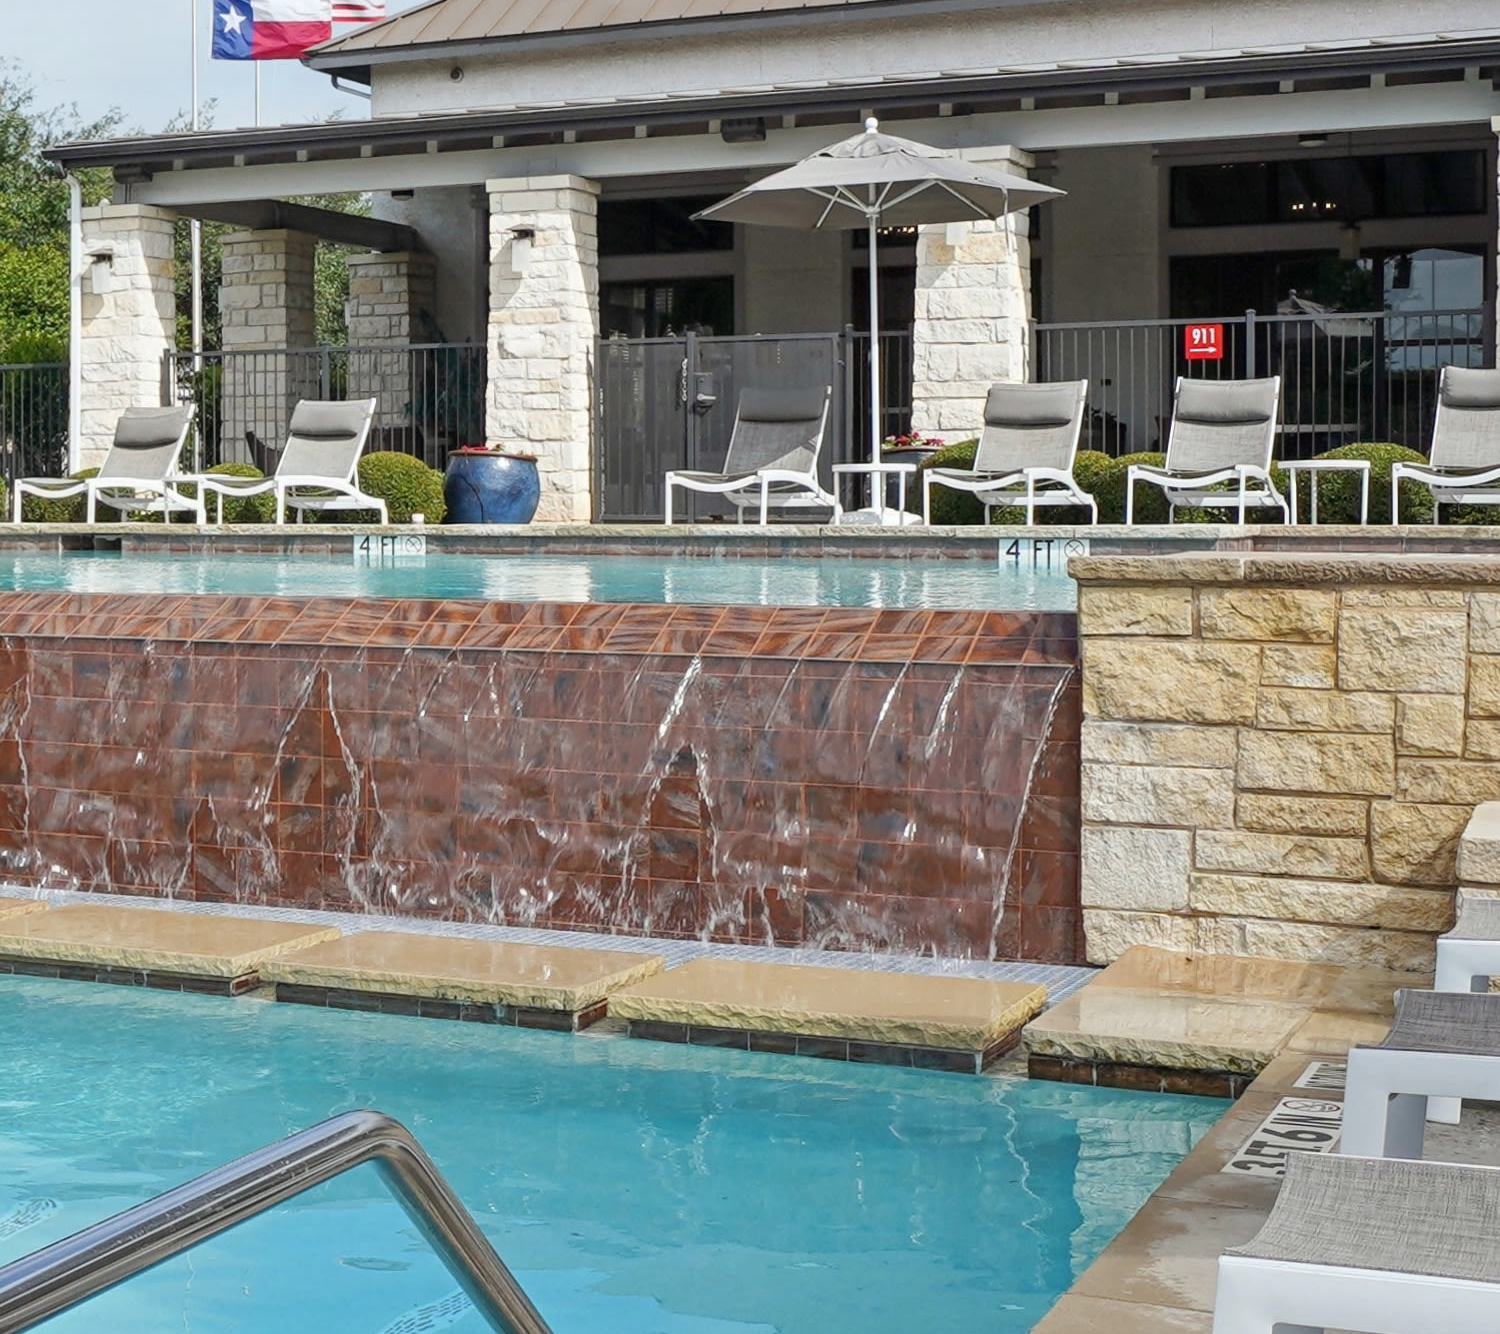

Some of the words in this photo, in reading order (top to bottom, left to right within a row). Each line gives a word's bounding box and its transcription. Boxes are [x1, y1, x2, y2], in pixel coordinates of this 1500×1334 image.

[1191, 328, 1216, 345] 911
[359, 534, 371, 561] 4
[381, 534, 398, 563] FT
[1006, 539, 1020, 566] 4
[1033, 539, 1054, 567] FT
[1260, 1127, 1333, 1143] 6
